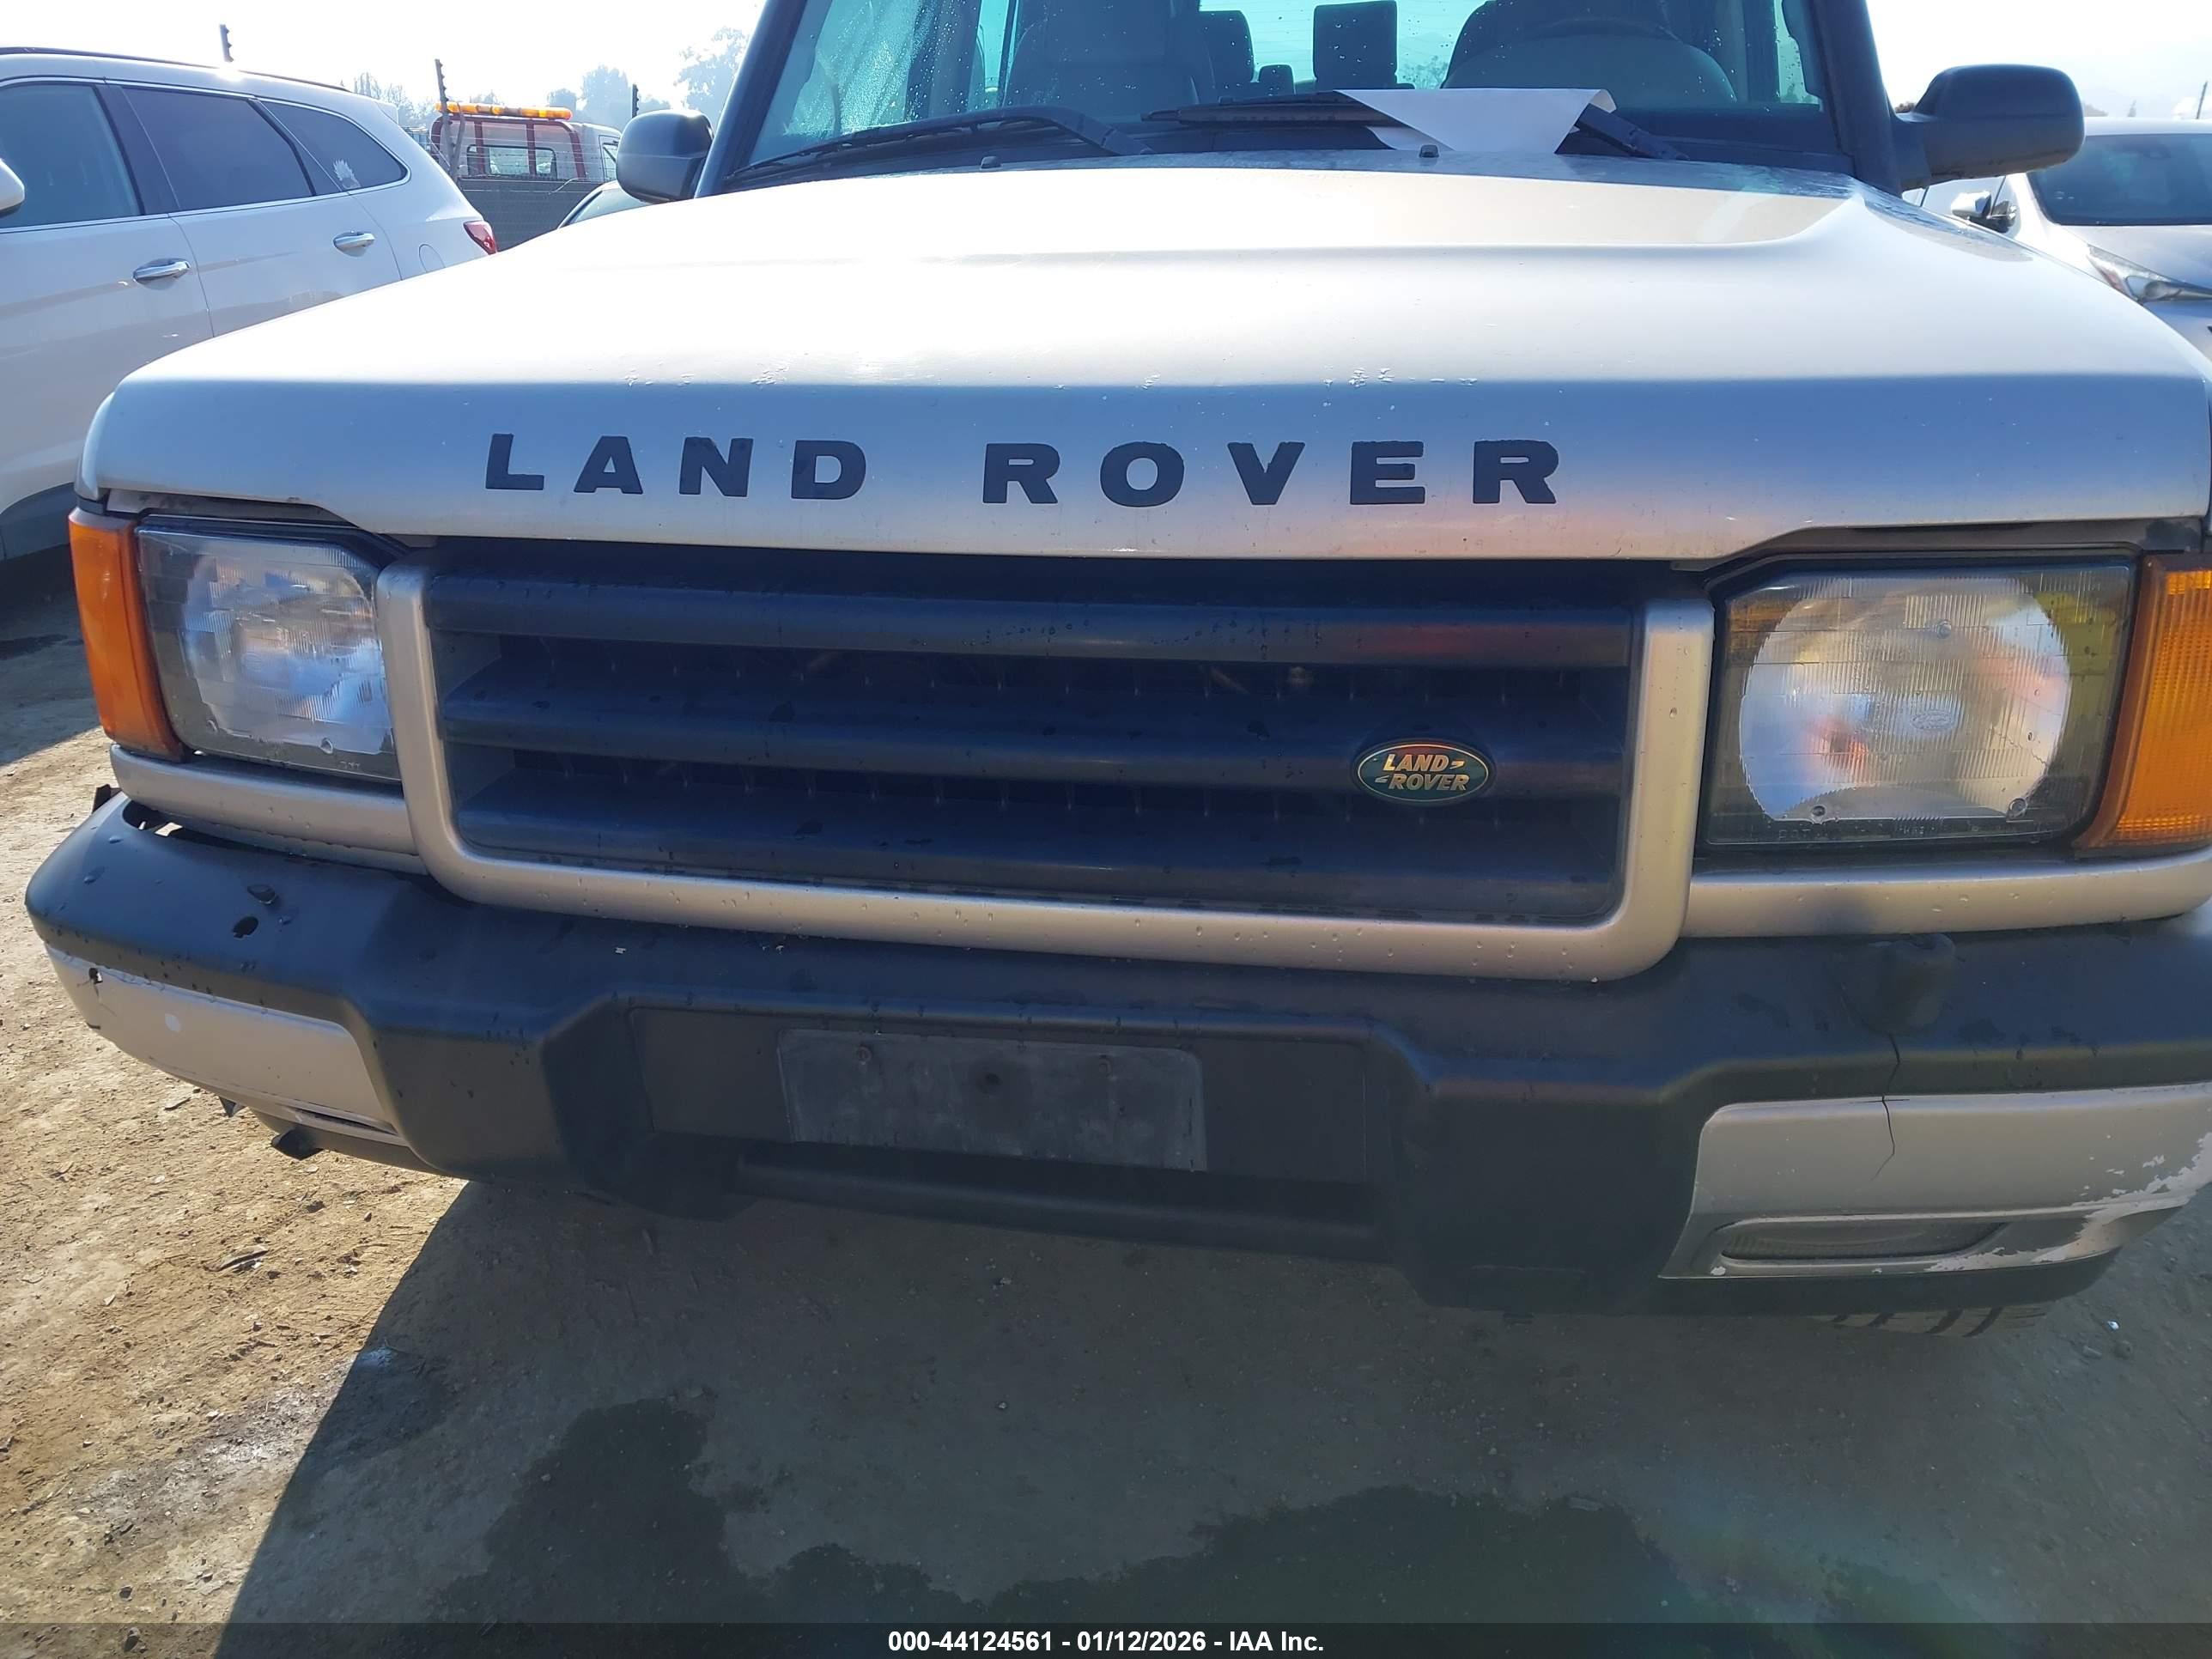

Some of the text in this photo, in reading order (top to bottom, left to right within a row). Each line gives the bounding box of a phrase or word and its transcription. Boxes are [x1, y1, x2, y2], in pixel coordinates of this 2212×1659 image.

[485, 433, 1559, 507] LAND ROVER
[1382, 753, 1449, 772] LAND
[1388, 773, 1470, 791] ROVER
